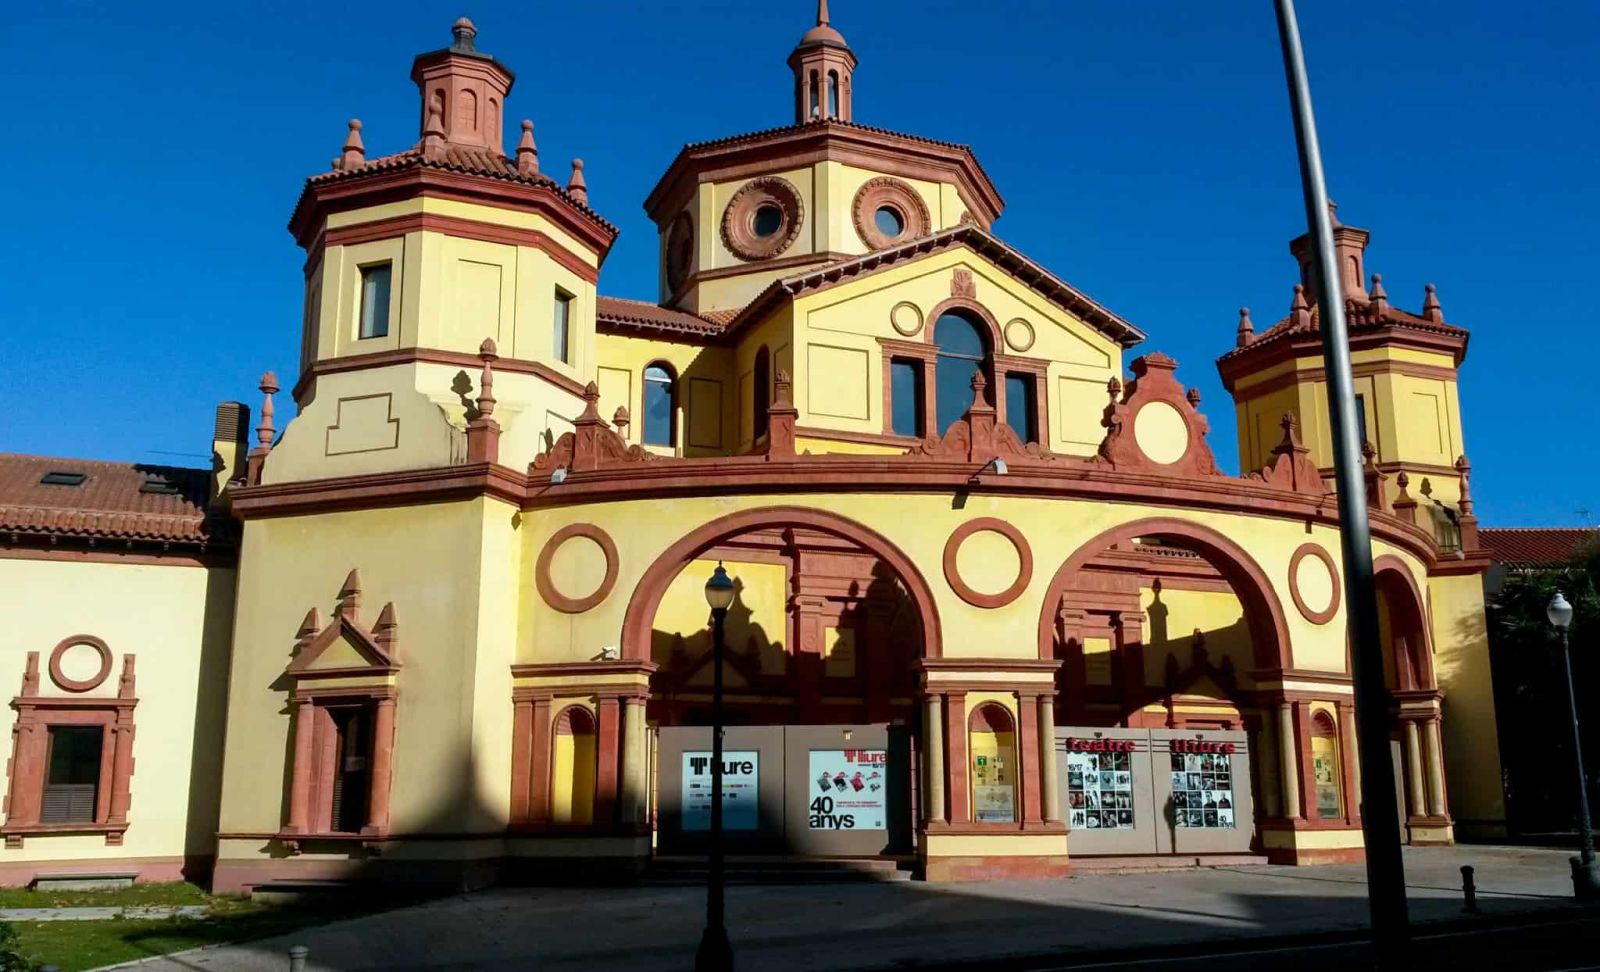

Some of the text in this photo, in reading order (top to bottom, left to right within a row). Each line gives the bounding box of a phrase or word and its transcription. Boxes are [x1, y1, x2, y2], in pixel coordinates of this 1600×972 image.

[1067, 737, 1236, 754] teatre lliure
[710, 757, 754, 775] lure
[810, 796, 834, 815] 40
[809, 814, 855, 830] anys
